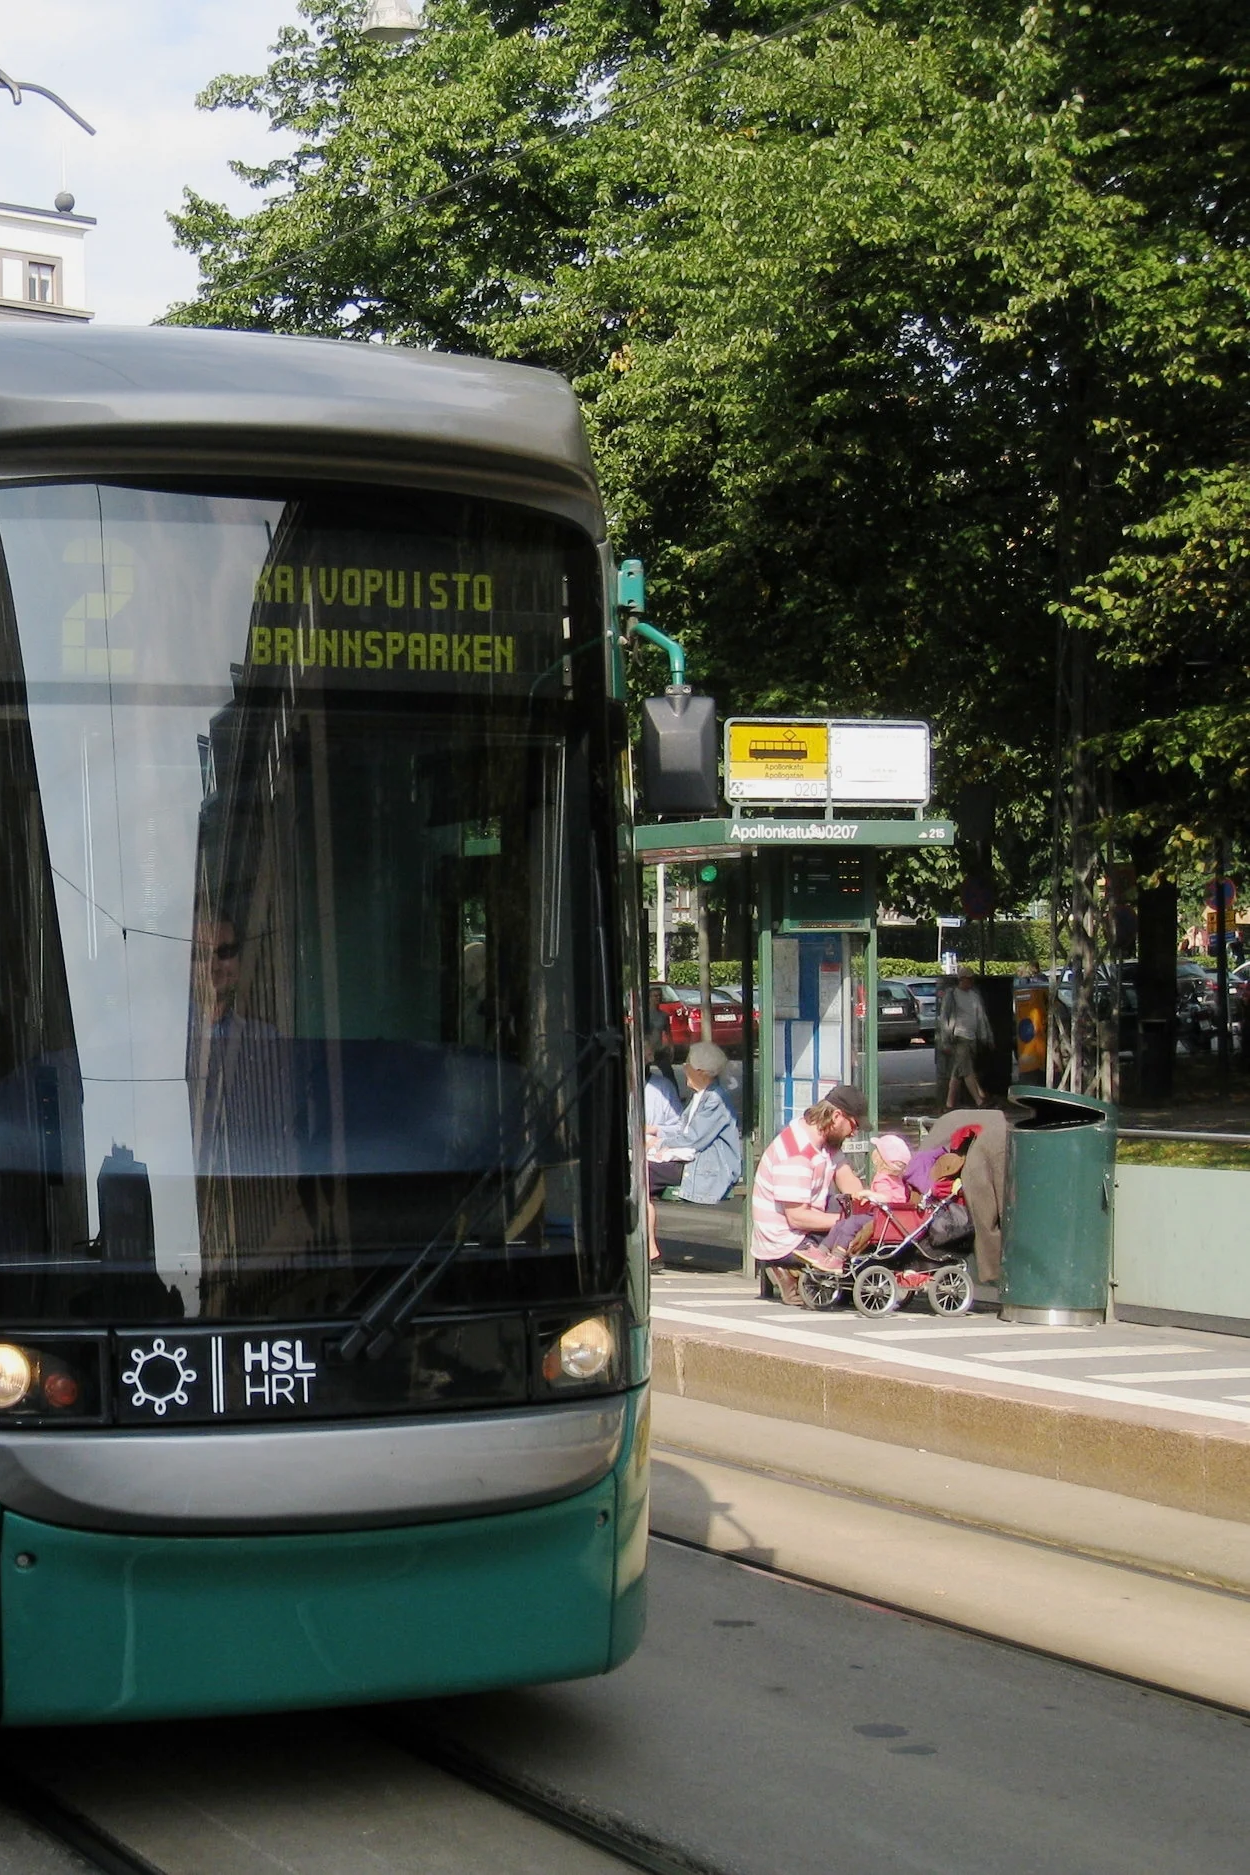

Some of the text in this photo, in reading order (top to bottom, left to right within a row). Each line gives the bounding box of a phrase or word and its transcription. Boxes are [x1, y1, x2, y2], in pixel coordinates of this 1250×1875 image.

[252, 564, 492, 611] KAIVOPUISTO
[62, 537, 135, 676] 2
[252, 627, 514, 673] BRUNNSPARKEN
[835, 766, 842, 778] 8
[795, 783, 826, 796] 0207
[244, 1340, 316, 1372] HSL
[245, 1373, 316, 1405] HRT
